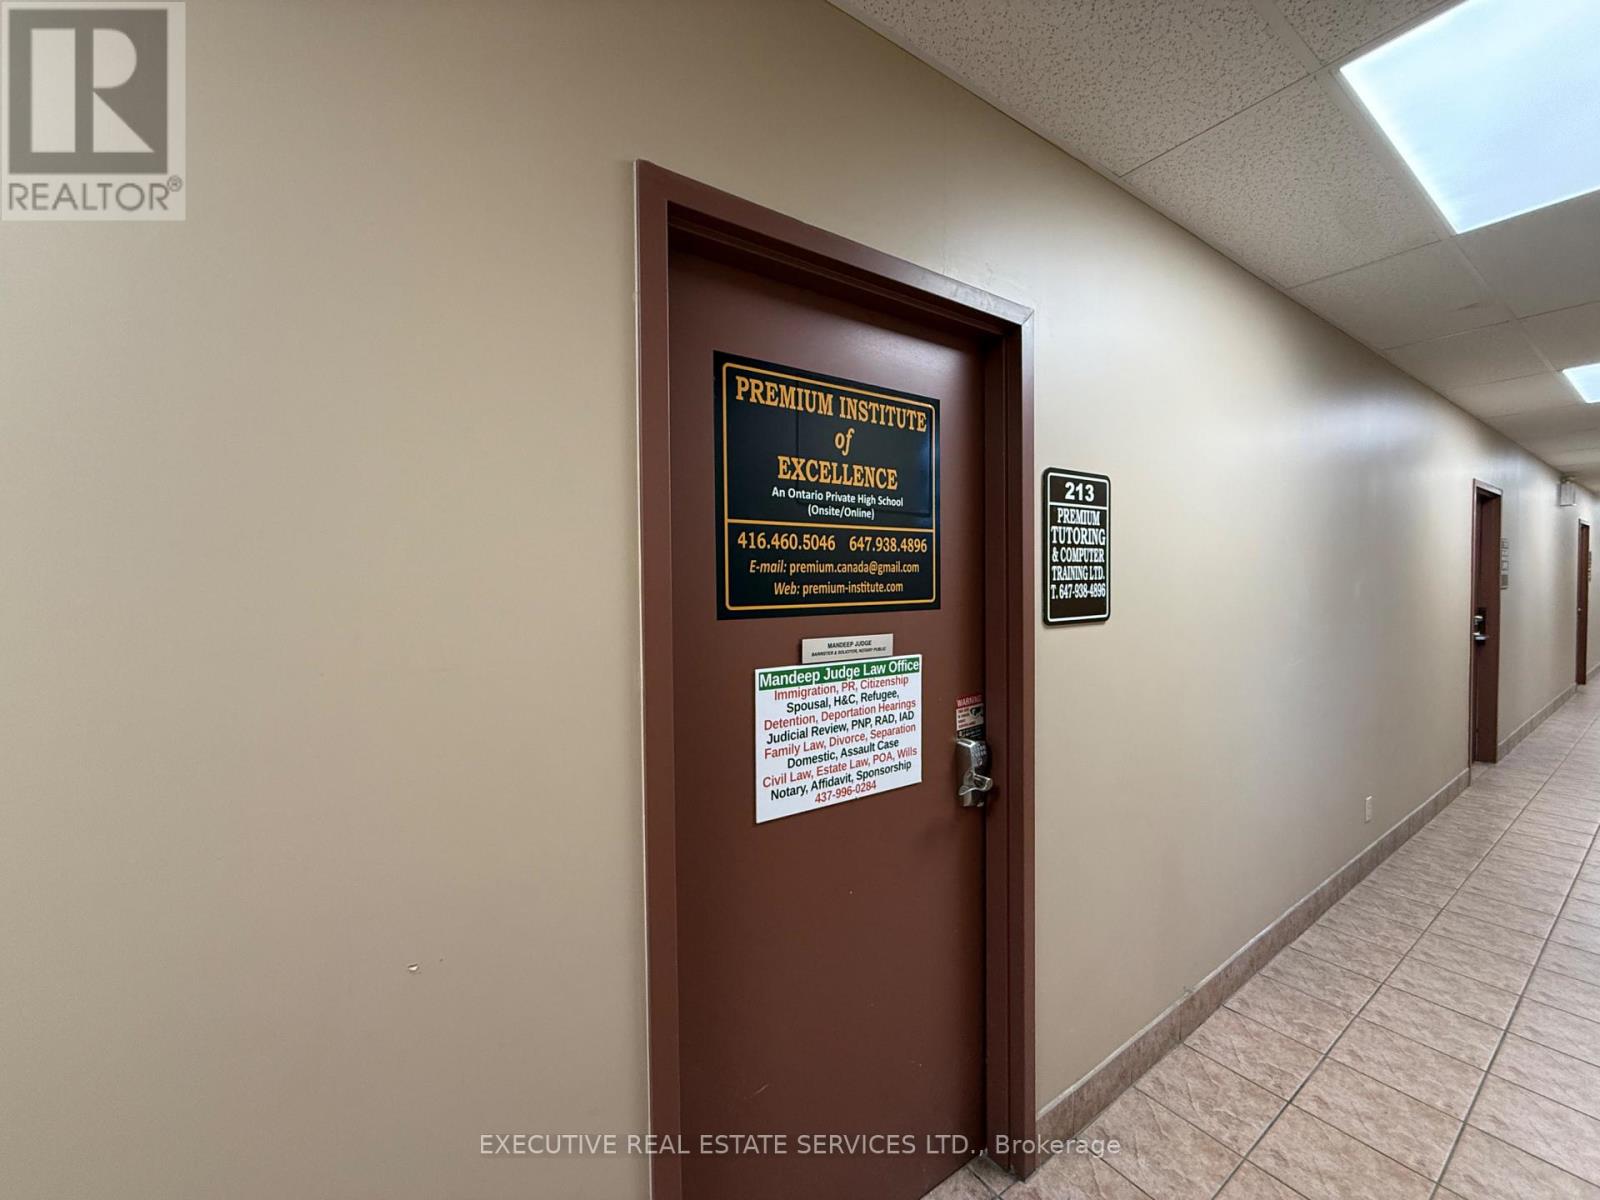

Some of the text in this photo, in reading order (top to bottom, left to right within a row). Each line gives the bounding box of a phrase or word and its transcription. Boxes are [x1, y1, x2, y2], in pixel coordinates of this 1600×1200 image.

[735, 375, 927, 432] PREMIUM INSTITUTE
[834, 428, 855, 456] of
[777, 455, 898, 490] EXCELLENCE
[771, 486, 904, 507] An Ontario Private High School
[1064, 481, 1095, 502] 213
[807, 505, 875, 520] (Onsite/Online)
[1057, 507, 1101, 526] PREMIUM
[737, 531, 928, 553] 416.460.5046 647.938.4896
[1050, 525, 1106, 545] TUTORING
[1051, 547, 1105, 563] & COMPUTER
[749, 559, 920, 576] E-mail: premium.canada@gmail.com
[1051, 565, 1105, 581] TRAINING LTD.
[774, 581, 904, 597] Web: premium-institute.com
[1050, 583, 1106, 599] T. 647-938-4896
[760, 659, 919, 688] Mandeep Judge Law Office
[774, 675, 909, 700] Immigration, PR, Citizenship
[786, 689, 899, 715] Spousal, H&C, Refugee,
[764, 700, 916, 731] Detention, Deportation Hearings
[766, 710, 915, 744] Judicial Review, PNP, RAD, IAD
[764, 723, 916, 759] Family Law, Divorce, Separation
[787, 739, 899, 768] Domestic, Assault Case
[762, 747, 918, 788] Civil Law, Estate Law, POA, Wills
[770, 760, 912, 800] Notary, Affidavit, Sponsorship
[815, 780, 877, 803] 437-996-0284
